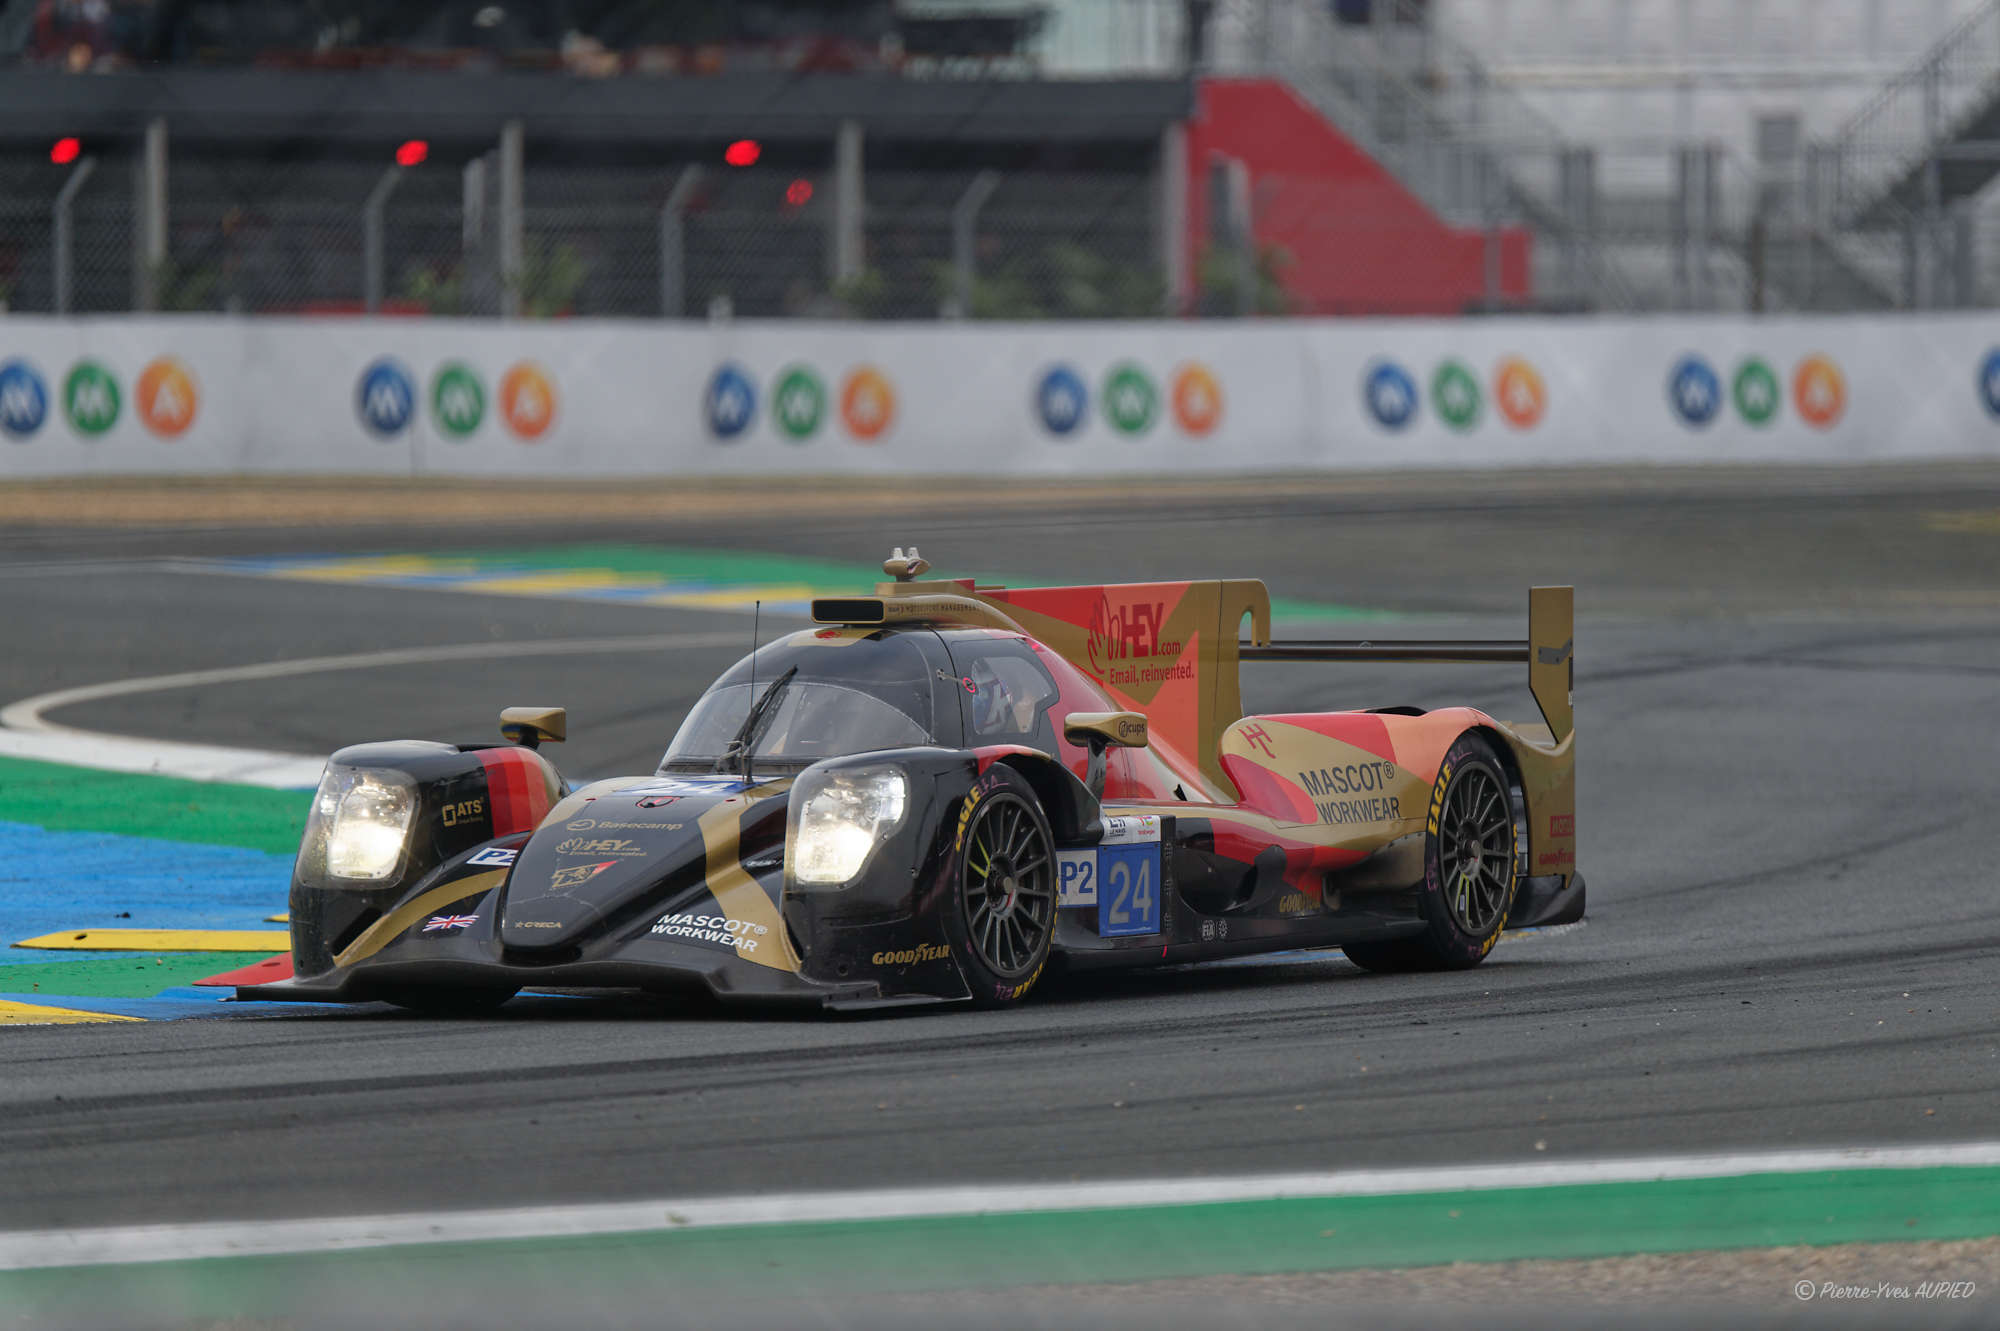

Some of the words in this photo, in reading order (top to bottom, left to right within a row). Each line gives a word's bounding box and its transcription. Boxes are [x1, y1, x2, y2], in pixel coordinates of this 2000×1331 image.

[1109, 664, 1140, 687] Email,
[1141, 660, 1194, 682] reinvented.
[1315, 796, 1401, 825] WORKWEAR
[1427, 762, 1452, 837] EAGLE
[598, 821, 684, 831] Basecamp
[1060, 860, 1094, 895] P2
[1108, 858, 1153, 925] 24
[651, 924, 758, 952] WORKWEAR
[872, 943, 951, 966] GOODYEAR
